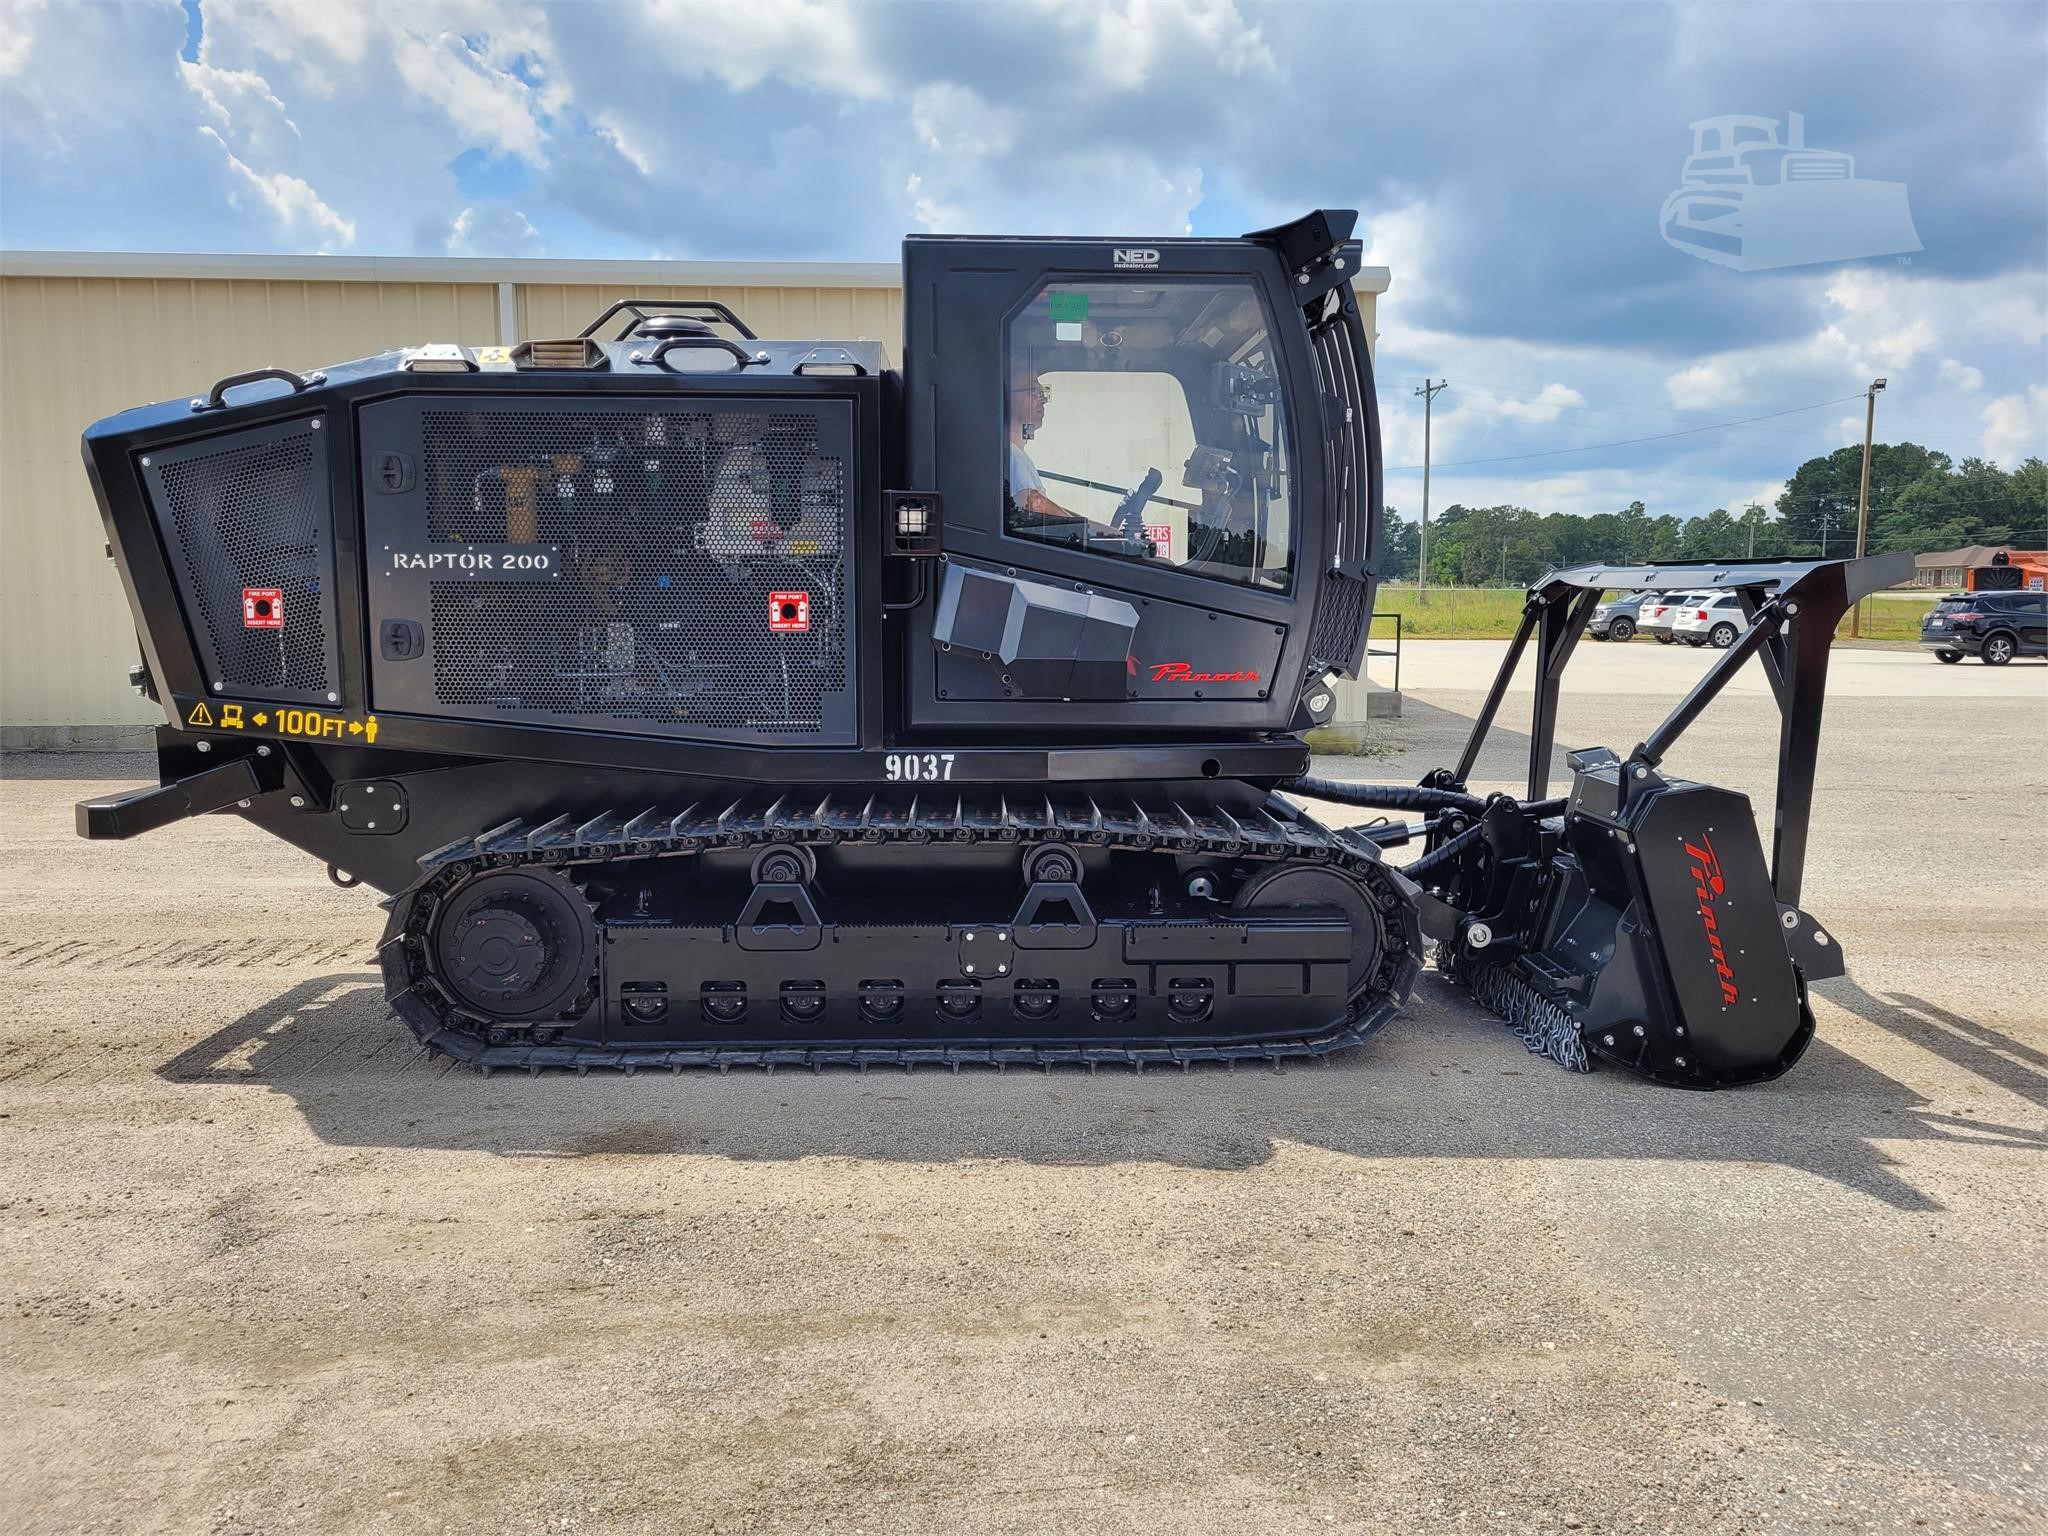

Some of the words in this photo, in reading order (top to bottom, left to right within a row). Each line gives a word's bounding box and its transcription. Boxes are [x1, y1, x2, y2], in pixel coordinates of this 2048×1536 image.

[1113, 249, 1160, 263] NED
[393, 553, 494, 569] RAPTOR
[502, 554, 549, 569] 200
[1150, 663, 1260, 681] Prinoth
[885, 754, 955, 780] 9037
[1684, 832, 1738, 1005] Prinoth
